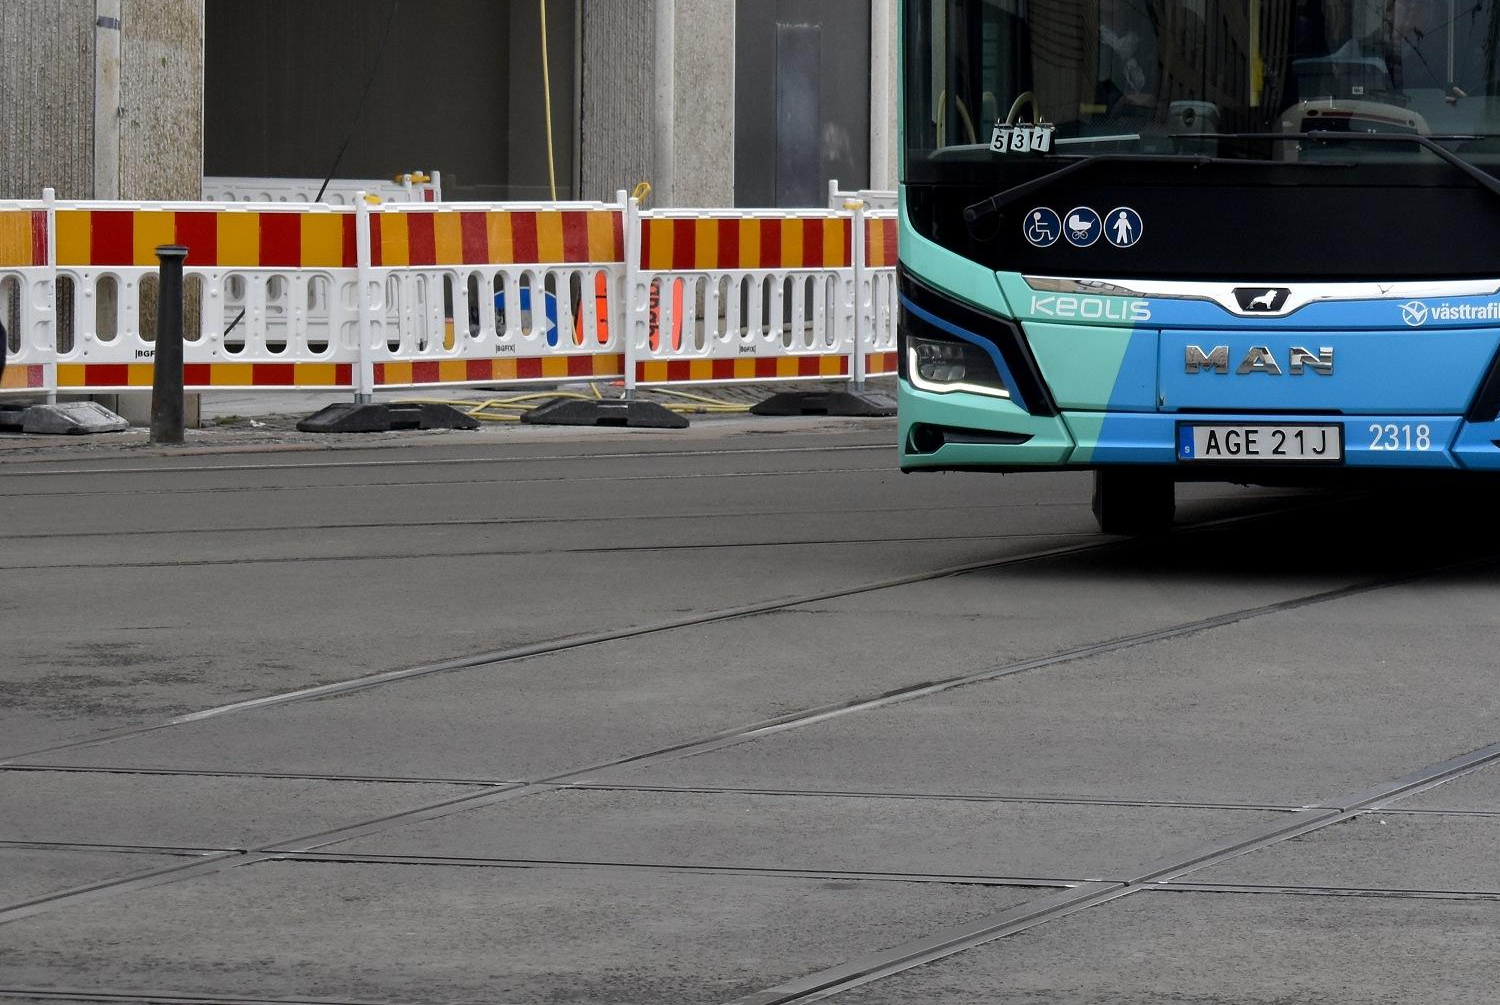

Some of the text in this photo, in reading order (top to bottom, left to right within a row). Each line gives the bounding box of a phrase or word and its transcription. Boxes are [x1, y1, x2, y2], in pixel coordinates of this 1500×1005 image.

[1184, 345, 1334, 376] MAN
[1205, 429, 1260, 455] AGE
[1271, 429, 1326, 455] 21J
[1368, 423, 1431, 451] 2318
